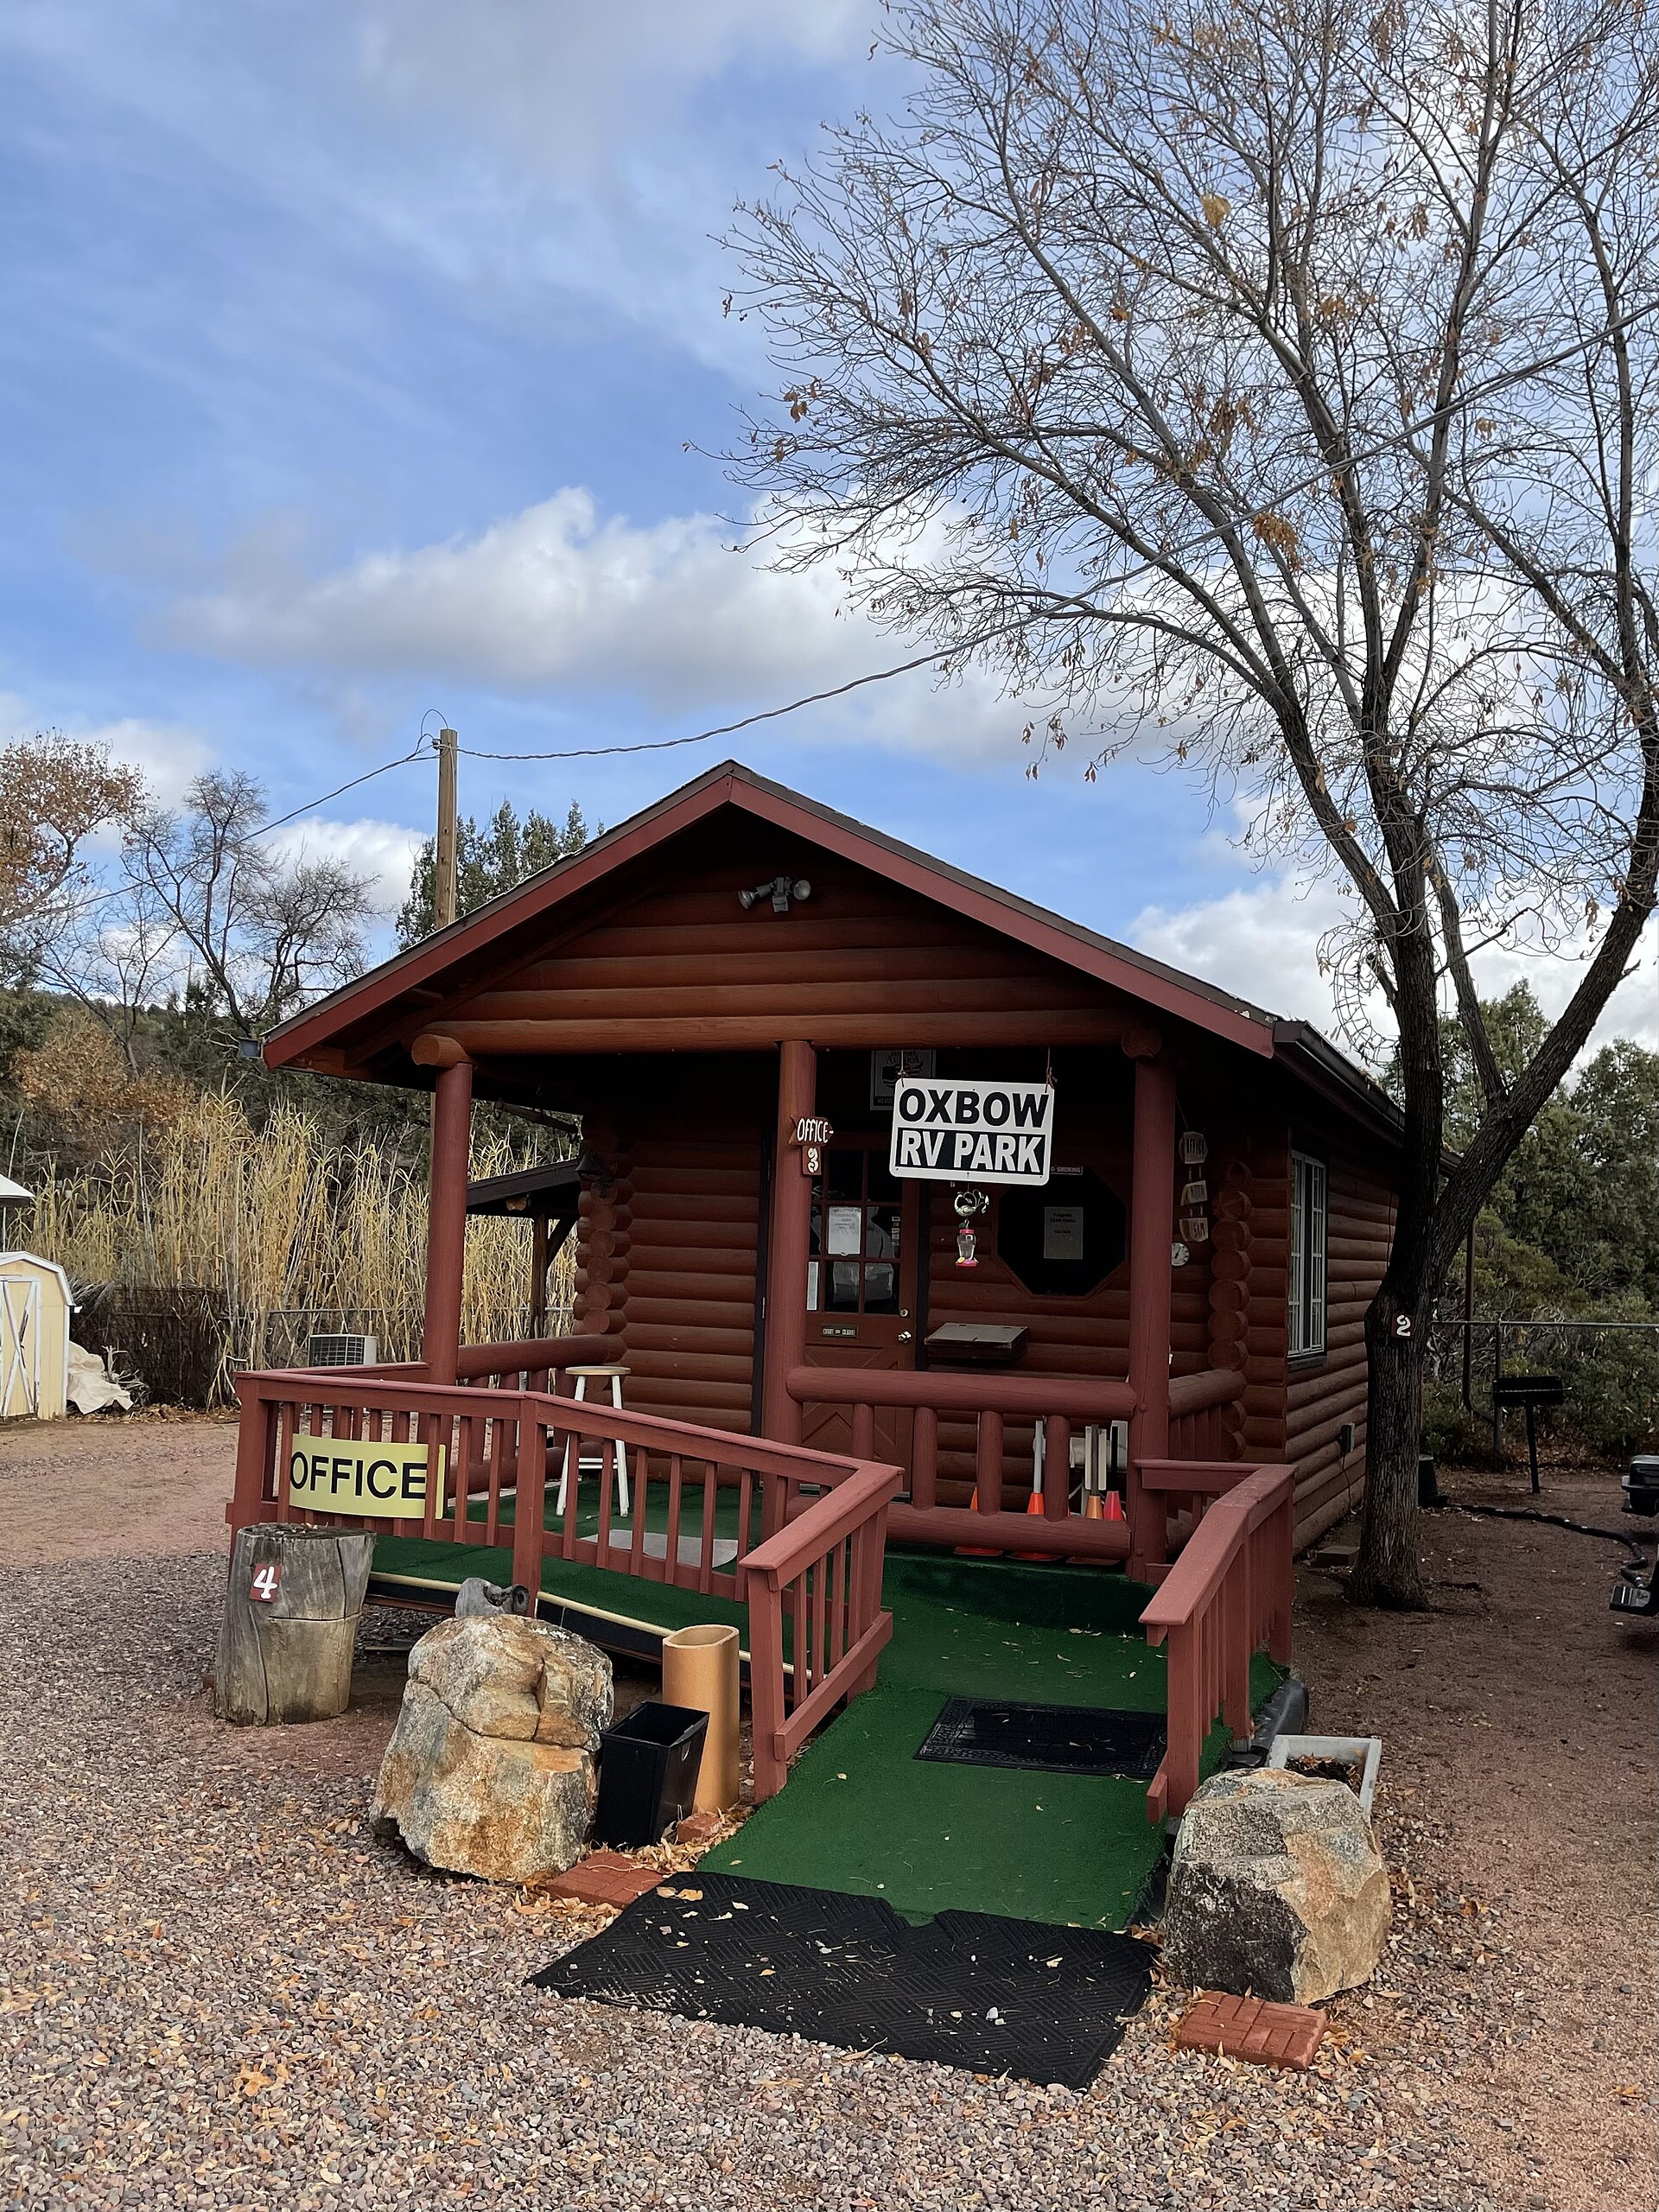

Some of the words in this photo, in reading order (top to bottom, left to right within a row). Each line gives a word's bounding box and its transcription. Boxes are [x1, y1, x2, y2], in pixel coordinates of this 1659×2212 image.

[899, 1088, 1049, 1128] OXBOW
[807, 1147, 820, 1173] 3
[899, 1130, 945, 1167] RV
[953, 1132, 1042, 1173] PARK
[1396, 1314, 1411, 1337] 2
[289, 1451, 428, 1499] OFFICE
[253, 1566, 279, 1599] 4
